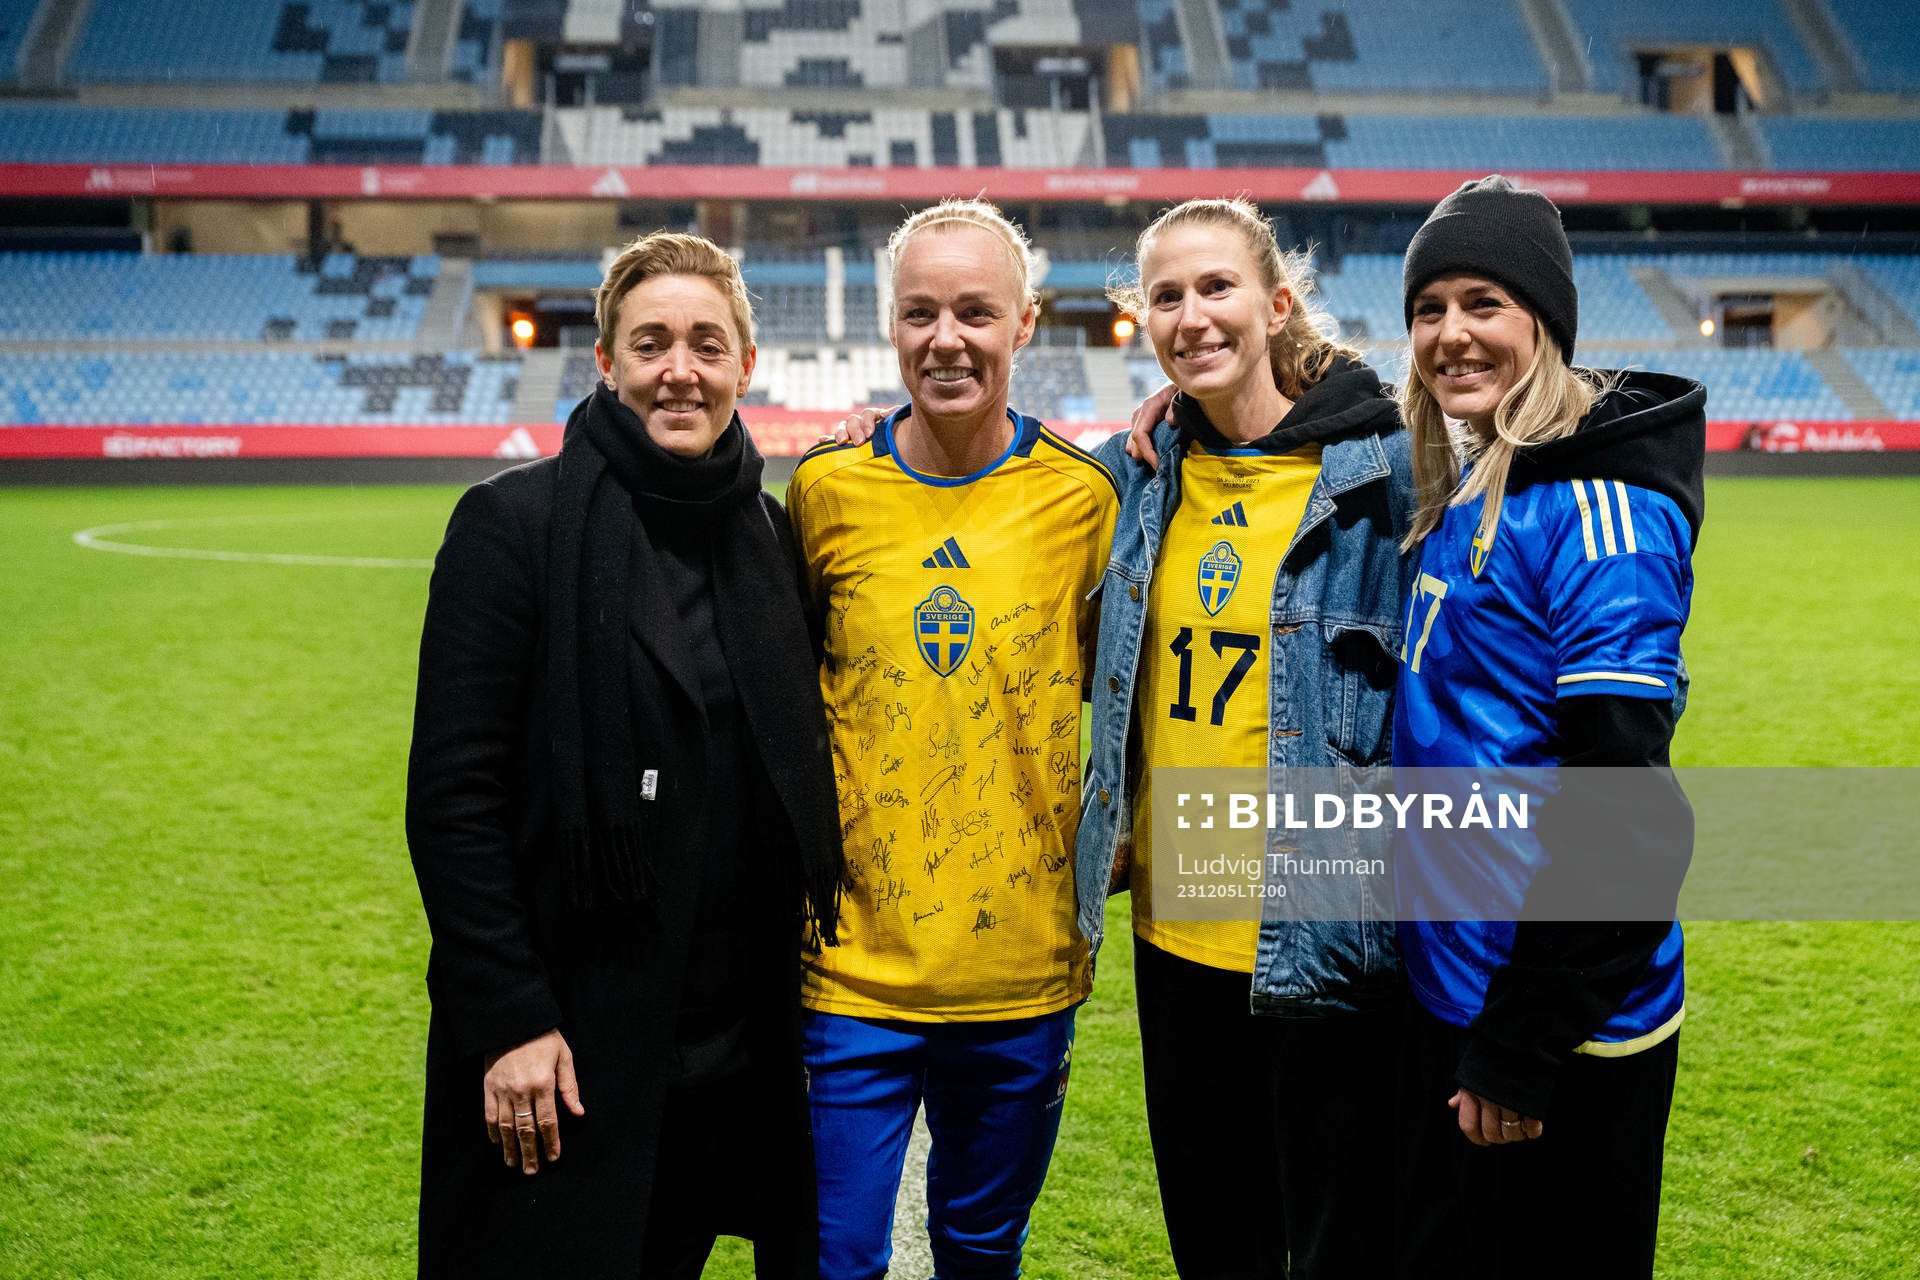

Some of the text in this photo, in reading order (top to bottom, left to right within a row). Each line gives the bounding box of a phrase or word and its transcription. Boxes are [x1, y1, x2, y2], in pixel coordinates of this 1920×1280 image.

[1207, 563, 1233, 571] SVERIGE
[1400, 566, 1448, 674] 17
[1169, 626, 1261, 727] 17
